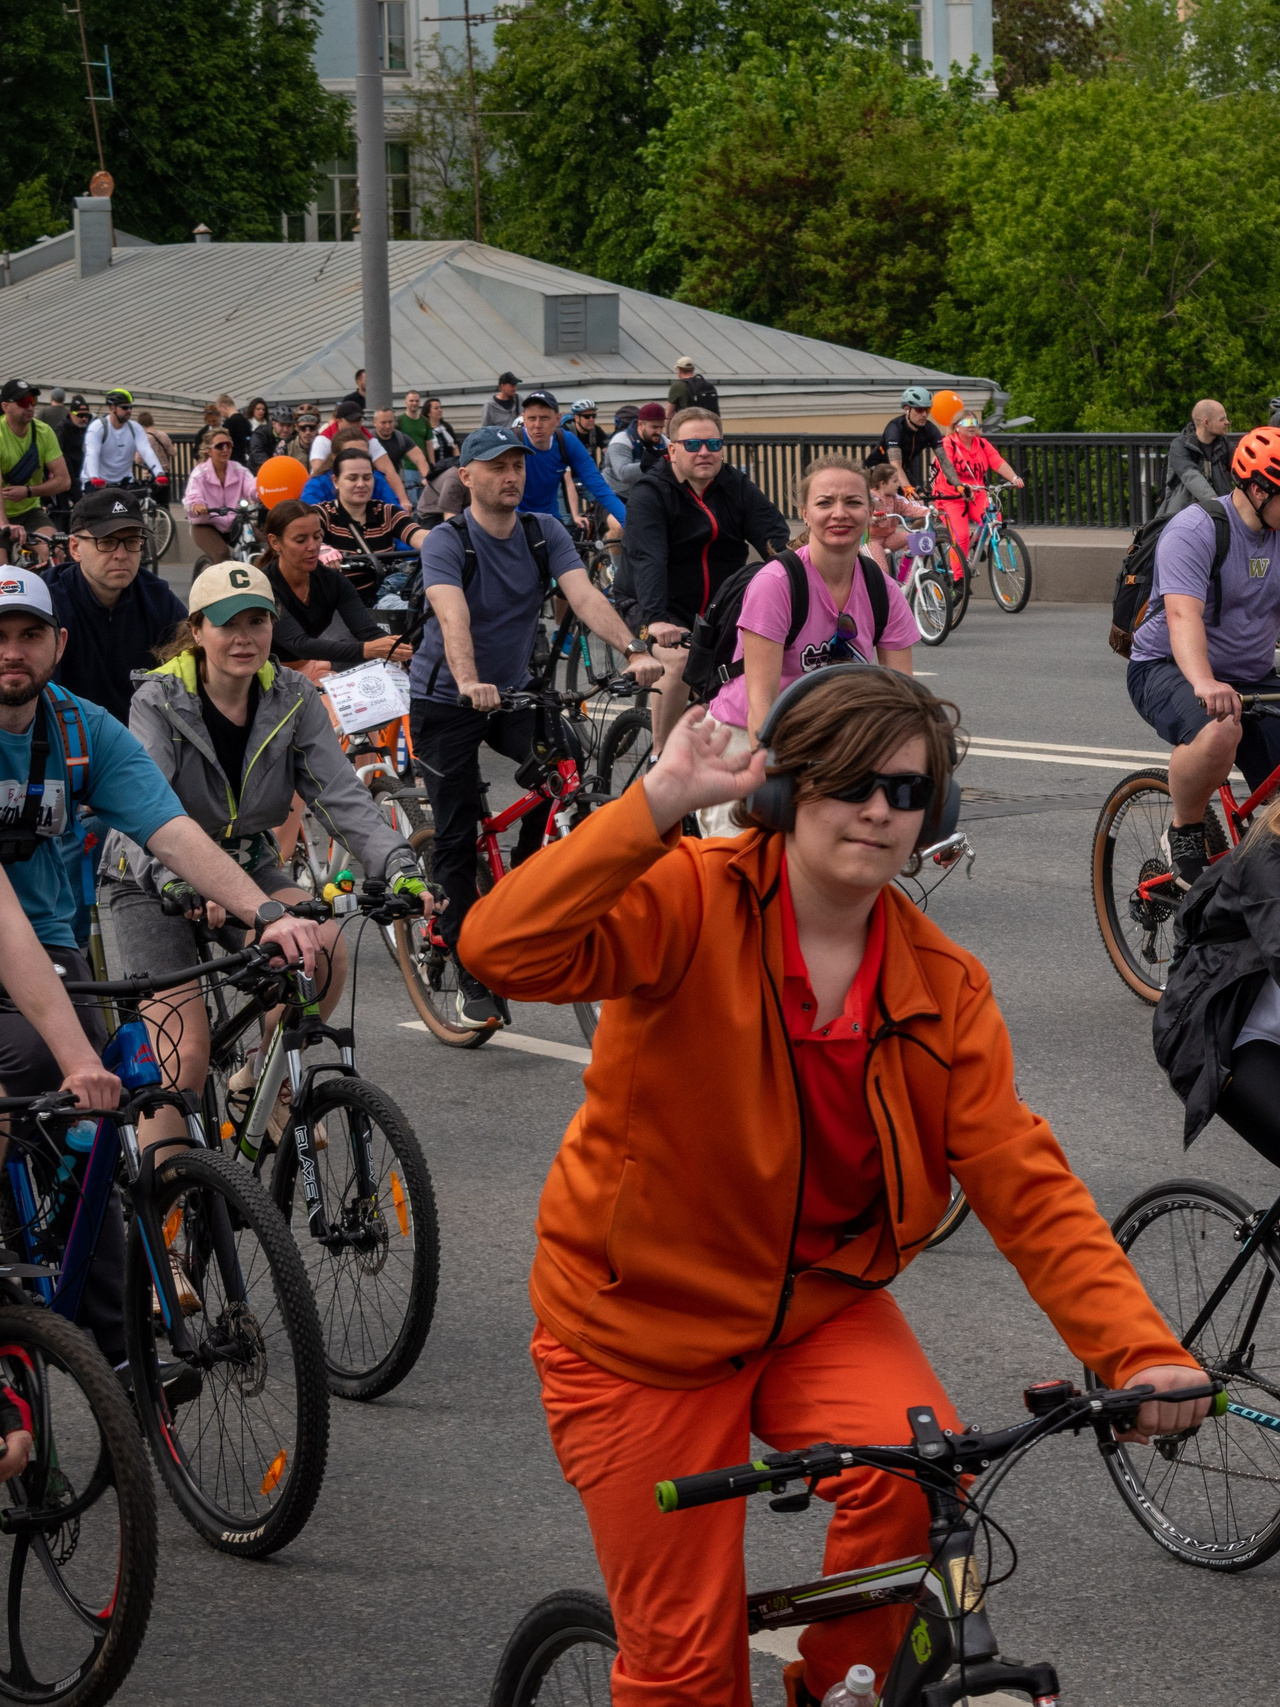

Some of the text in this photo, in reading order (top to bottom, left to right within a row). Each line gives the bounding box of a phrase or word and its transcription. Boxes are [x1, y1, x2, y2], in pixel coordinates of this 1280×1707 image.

[1249, 558, 1270, 578] W
[229, 569, 250, 588] C
[294, 1126, 320, 1200] BLAZE
[221, 1524, 266, 1543] MAXXIS
